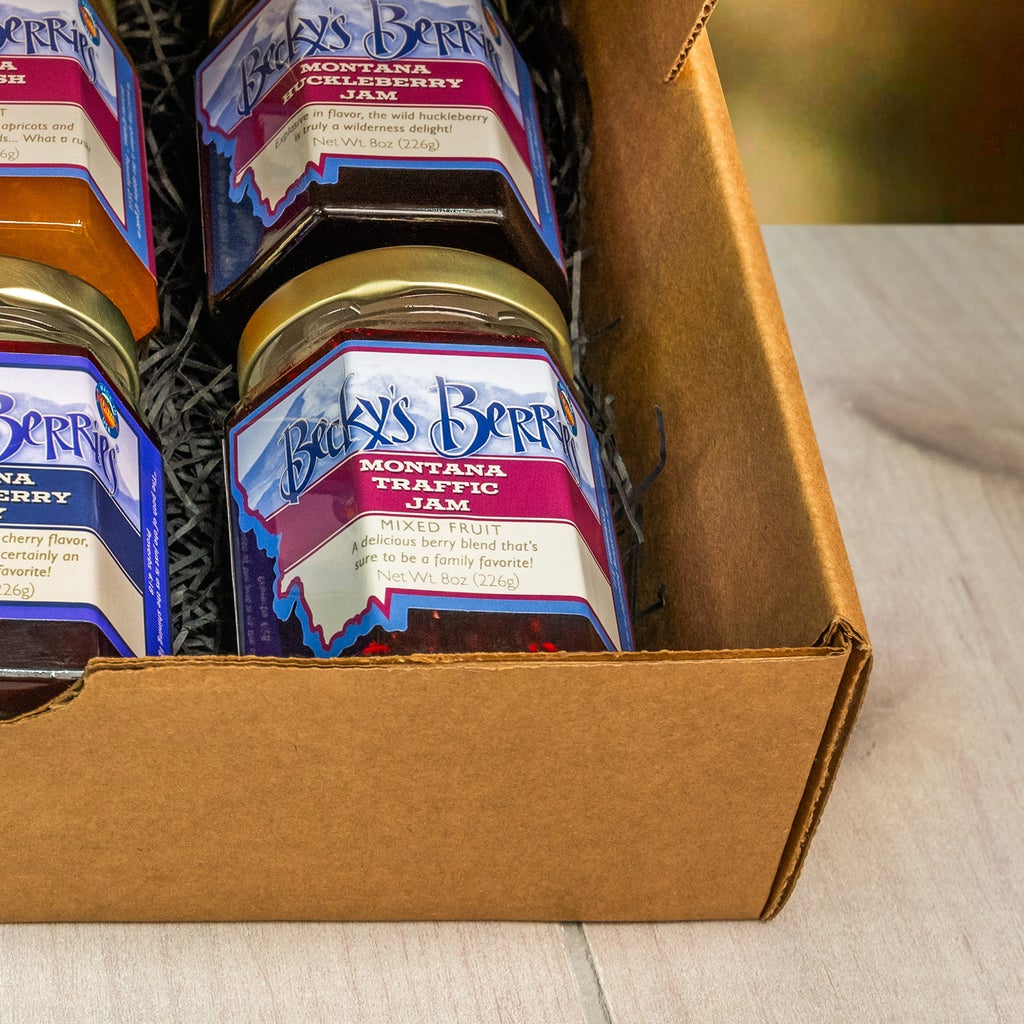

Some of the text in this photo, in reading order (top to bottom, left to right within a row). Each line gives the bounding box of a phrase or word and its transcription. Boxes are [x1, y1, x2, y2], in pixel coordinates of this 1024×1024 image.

[237, 0, 351, 117] Becky's
[300, 62, 431, 74] MONTANA
[282, 75, 463, 105] HUCKLEBERRY
[340, 90, 398, 101] JAM
[313, 109, 324, 117] in
[328, 109, 364, 120] flavor,
[368, 111, 385, 120] the
[391, 112, 415, 120] wild
[419, 112, 488, 124] huckleberry
[1, 121, 48, 131] apricots
[52, 122, 74, 131] and
[303, 121, 328, 134] truly
[344, 123, 405, 132] wilderness
[409, 124, 453, 135] delight!
[23, 133, 56, 143] What
[313, 137, 440, 151] Net Wt. 8oz (226g)
[280, 373, 410, 504] Becky's
[359, 459, 507, 477] MONTANA
[372, 477, 499, 495] TRAFFIC
[406, 498, 470, 511] JAM
[381, 520, 501, 535] MIXED FRUIT
[2, 533, 43, 546] cherry
[48, 534, 89, 548] flavor,
[352, 536, 537, 554] A delicious berry blend that's
[0, 549, 58, 563] certainly
[63, 553, 79, 561] an
[354, 553, 377, 570] sure
[383, 553, 395, 562] to
[402, 553, 416, 563] be
[434, 554, 474, 568] family
[479, 556, 533, 569] favorite!
[378, 570, 520, 590] Net Wt. 8oz (226g)
